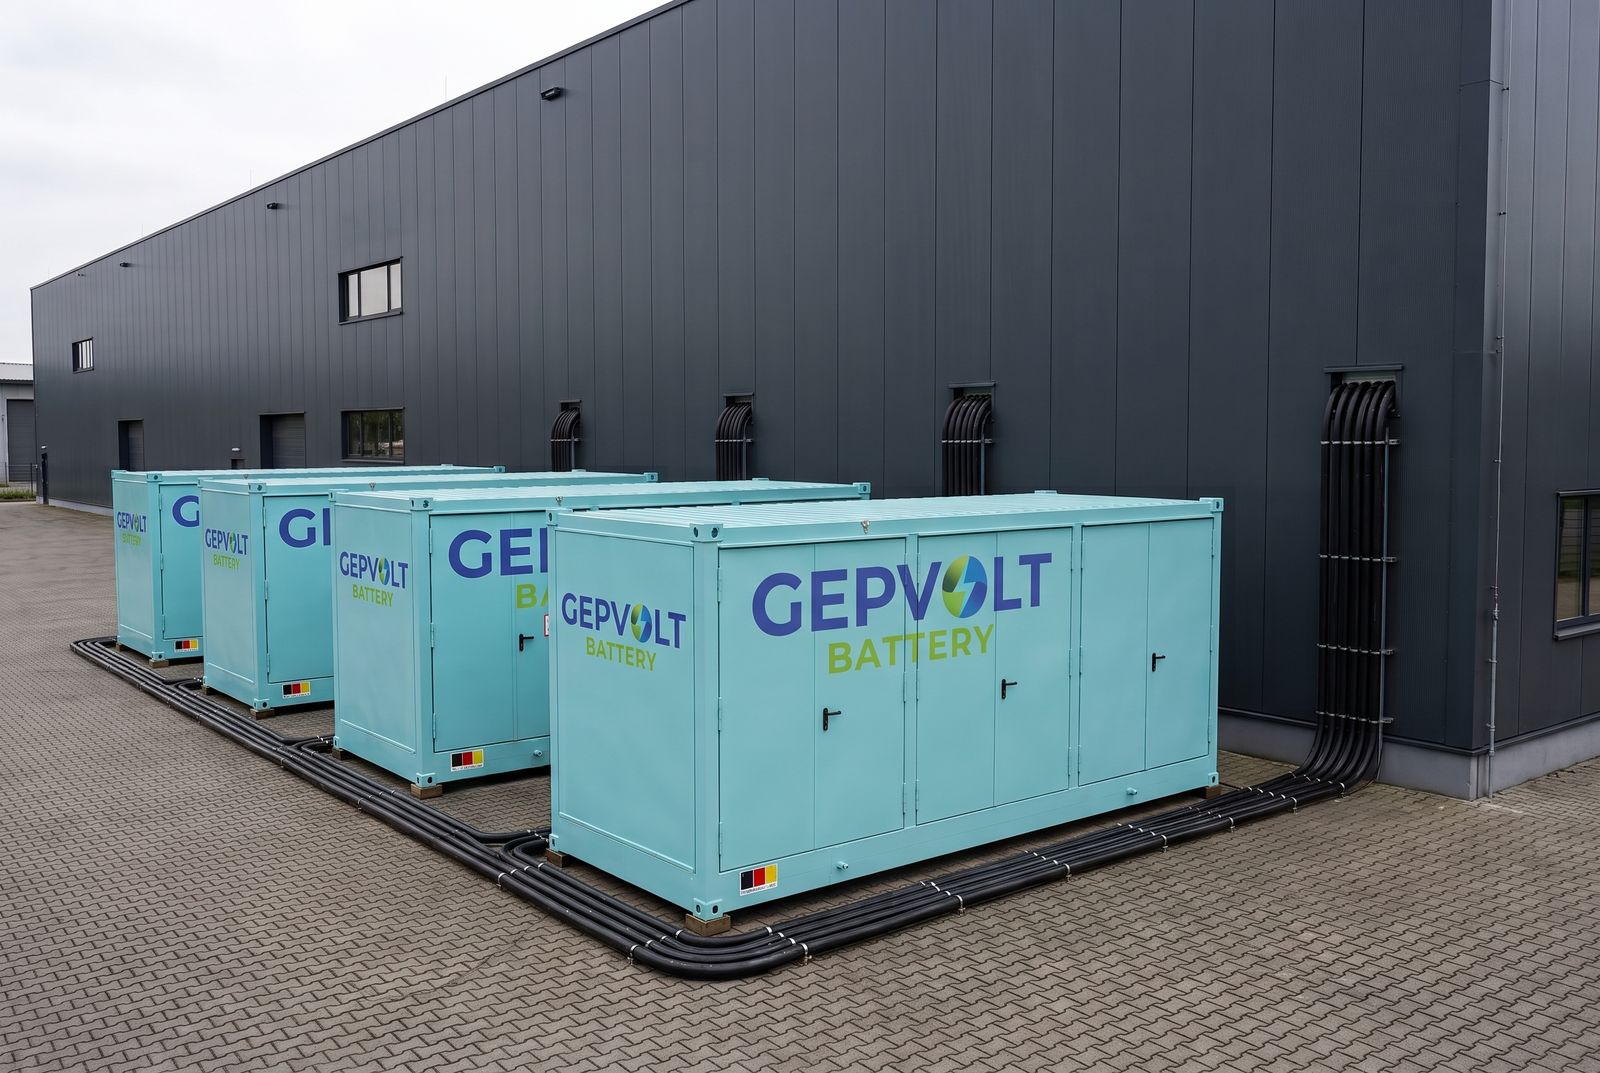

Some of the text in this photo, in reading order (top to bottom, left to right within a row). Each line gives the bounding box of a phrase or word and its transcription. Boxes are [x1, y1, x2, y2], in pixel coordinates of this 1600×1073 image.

[205, 528, 249, 555] GEPVOLT
[279, 508, 331, 548] G
[213, 554, 240, 570] BATTERY
[339, 551, 409, 589] GEPVOLT
[449, 528, 548, 579] GE
[352, 584, 394, 607] BATTERY
[752, 553, 1052, 637] GEPVOLT
[561, 592, 687, 649] GEPVOLT
[586, 636, 656, 672] BATTERY
[828, 623, 995, 674] BATTERY
